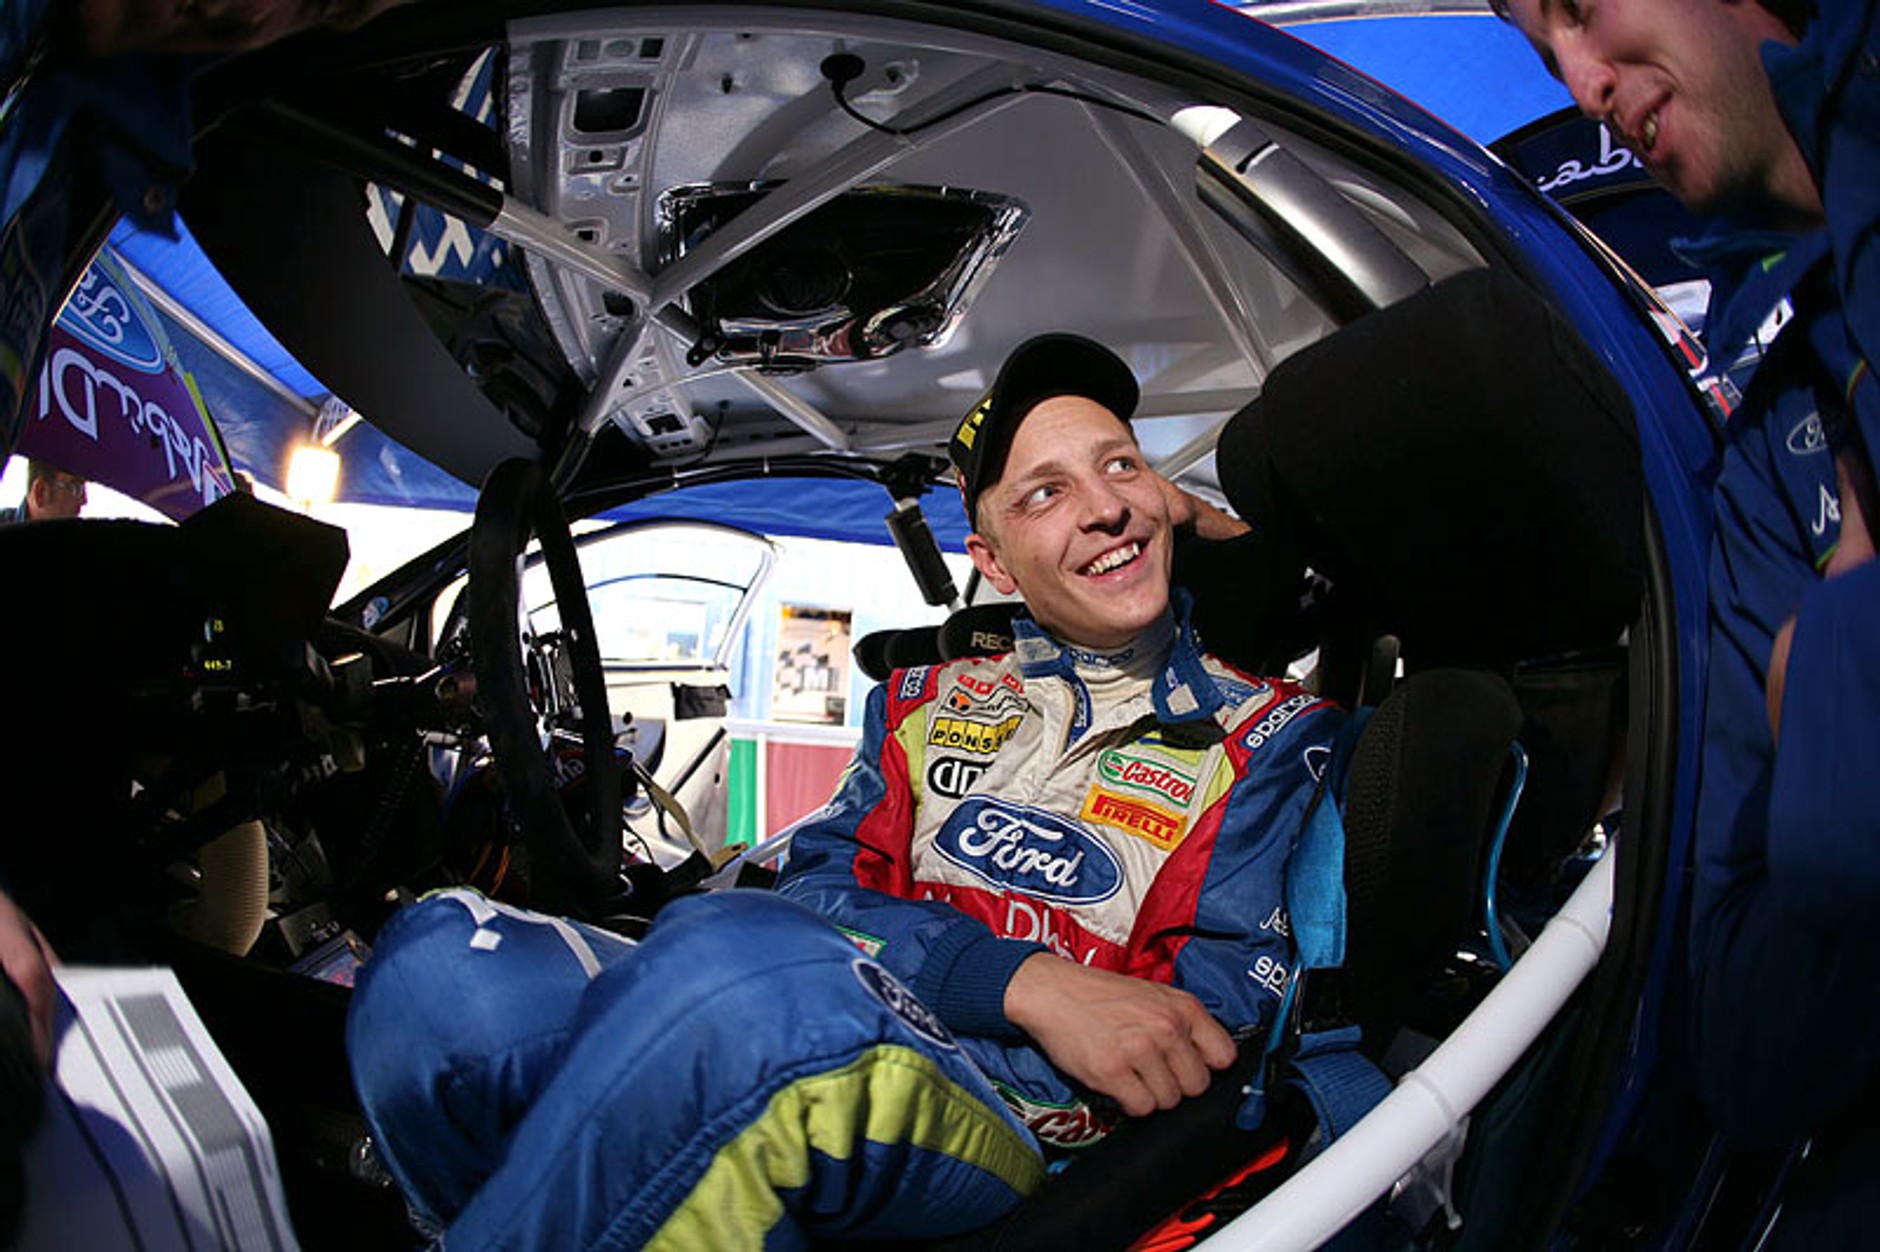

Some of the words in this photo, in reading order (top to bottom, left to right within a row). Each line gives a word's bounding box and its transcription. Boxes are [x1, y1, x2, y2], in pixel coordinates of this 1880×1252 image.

[1245, 693, 1318, 749] sparco
[1122, 760, 1197, 803] Castrol
[1091, 794, 1179, 842] PIRELLI
[957, 807, 1084, 889] Ford
